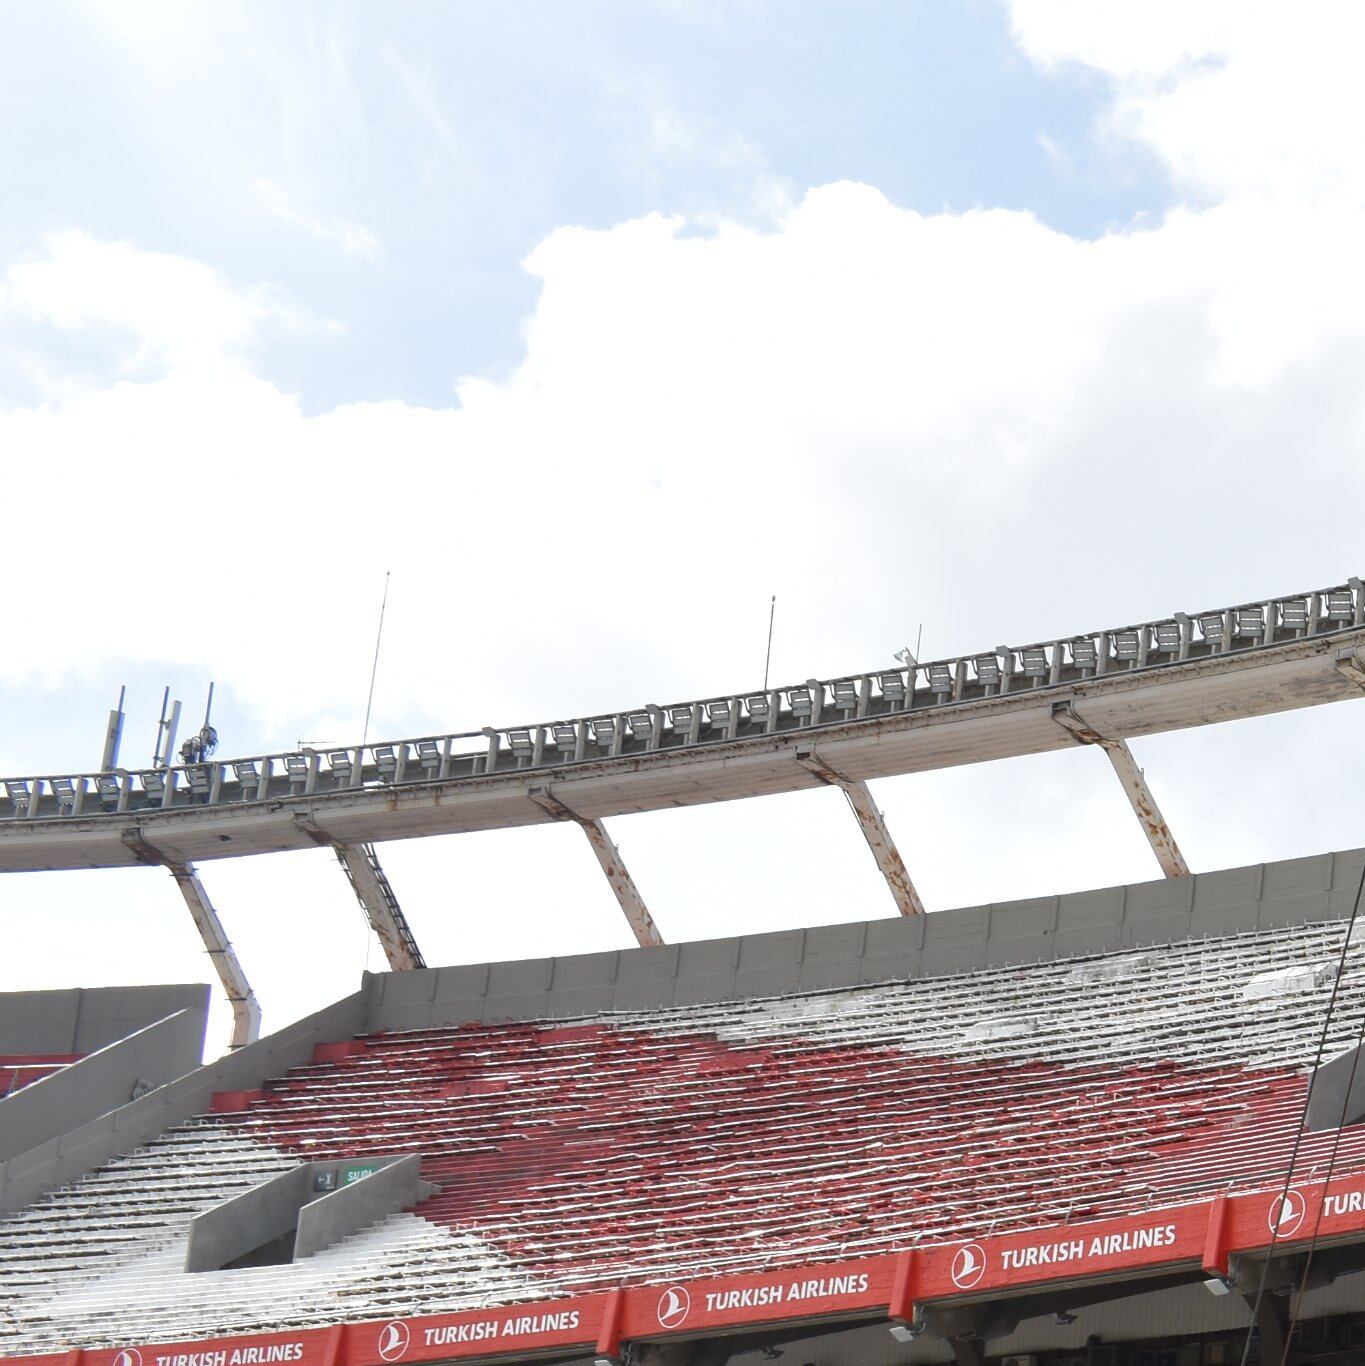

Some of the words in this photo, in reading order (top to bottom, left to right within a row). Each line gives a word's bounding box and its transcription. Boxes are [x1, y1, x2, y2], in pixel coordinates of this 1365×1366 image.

[1001, 1239, 1084, 1270] TURKISH
[1087, 1223, 1176, 1257] AIRLINES
[706, 1284, 783, 1312] TURKISH
[787, 1272, 869, 1301] AIRLINES
[425, 1320, 498, 1346] TURKISH
[502, 1310, 580, 1337] AIRLINES
[230, 1342, 303, 1366] AIRLINES
